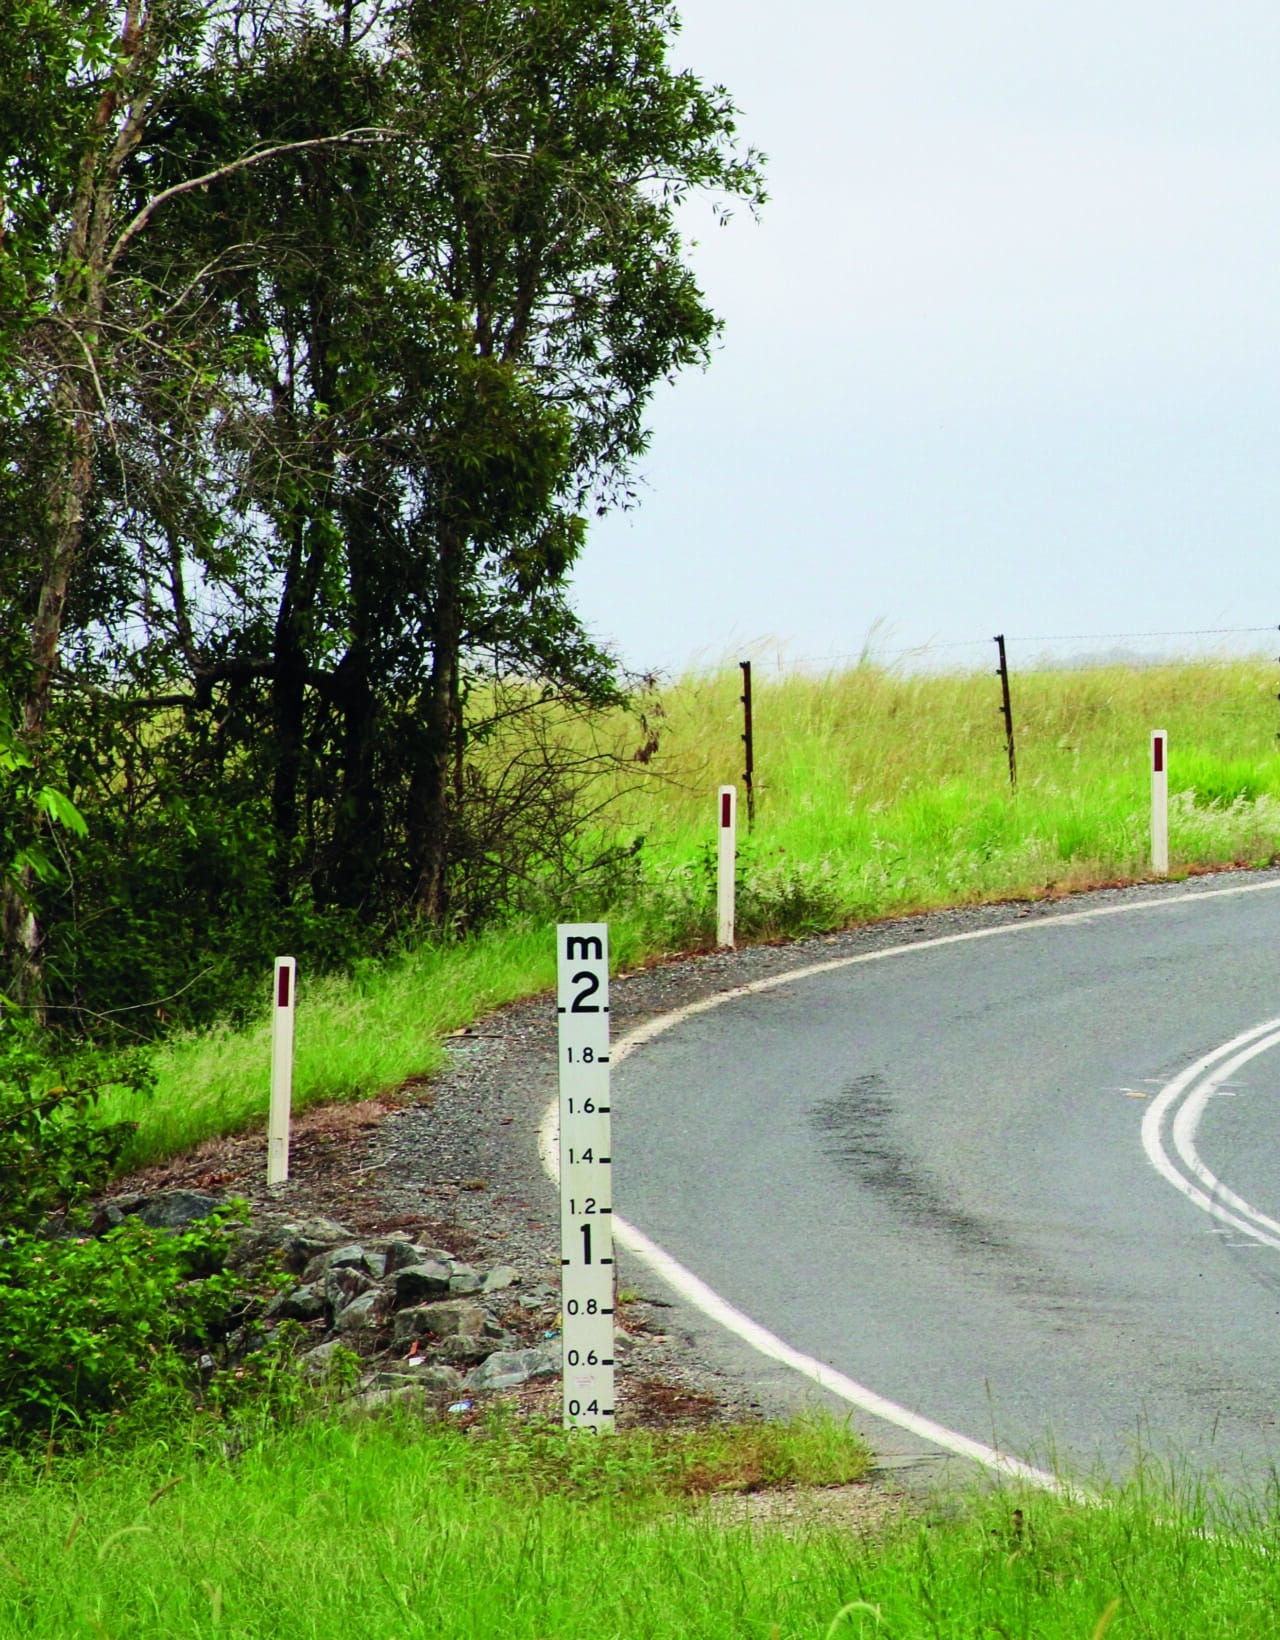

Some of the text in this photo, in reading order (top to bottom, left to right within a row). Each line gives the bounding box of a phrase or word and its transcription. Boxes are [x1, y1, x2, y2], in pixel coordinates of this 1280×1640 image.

[566, 936, 603, 960] m
[571, 971, 600, 1013] 2
[567, 1047, 594, 1064] 1.8
[568, 1097, 595, 1114] 1.6
[569, 1148, 594, 1164] 1.4
[569, 1198, 596, 1215] 1.2
[580, 1223, 592, 1265] 1
[567, 1299, 598, 1316] 0.8
[567, 1350, 598, 1366] 0.6
[568, 1400, 599, 1416] 0.4
